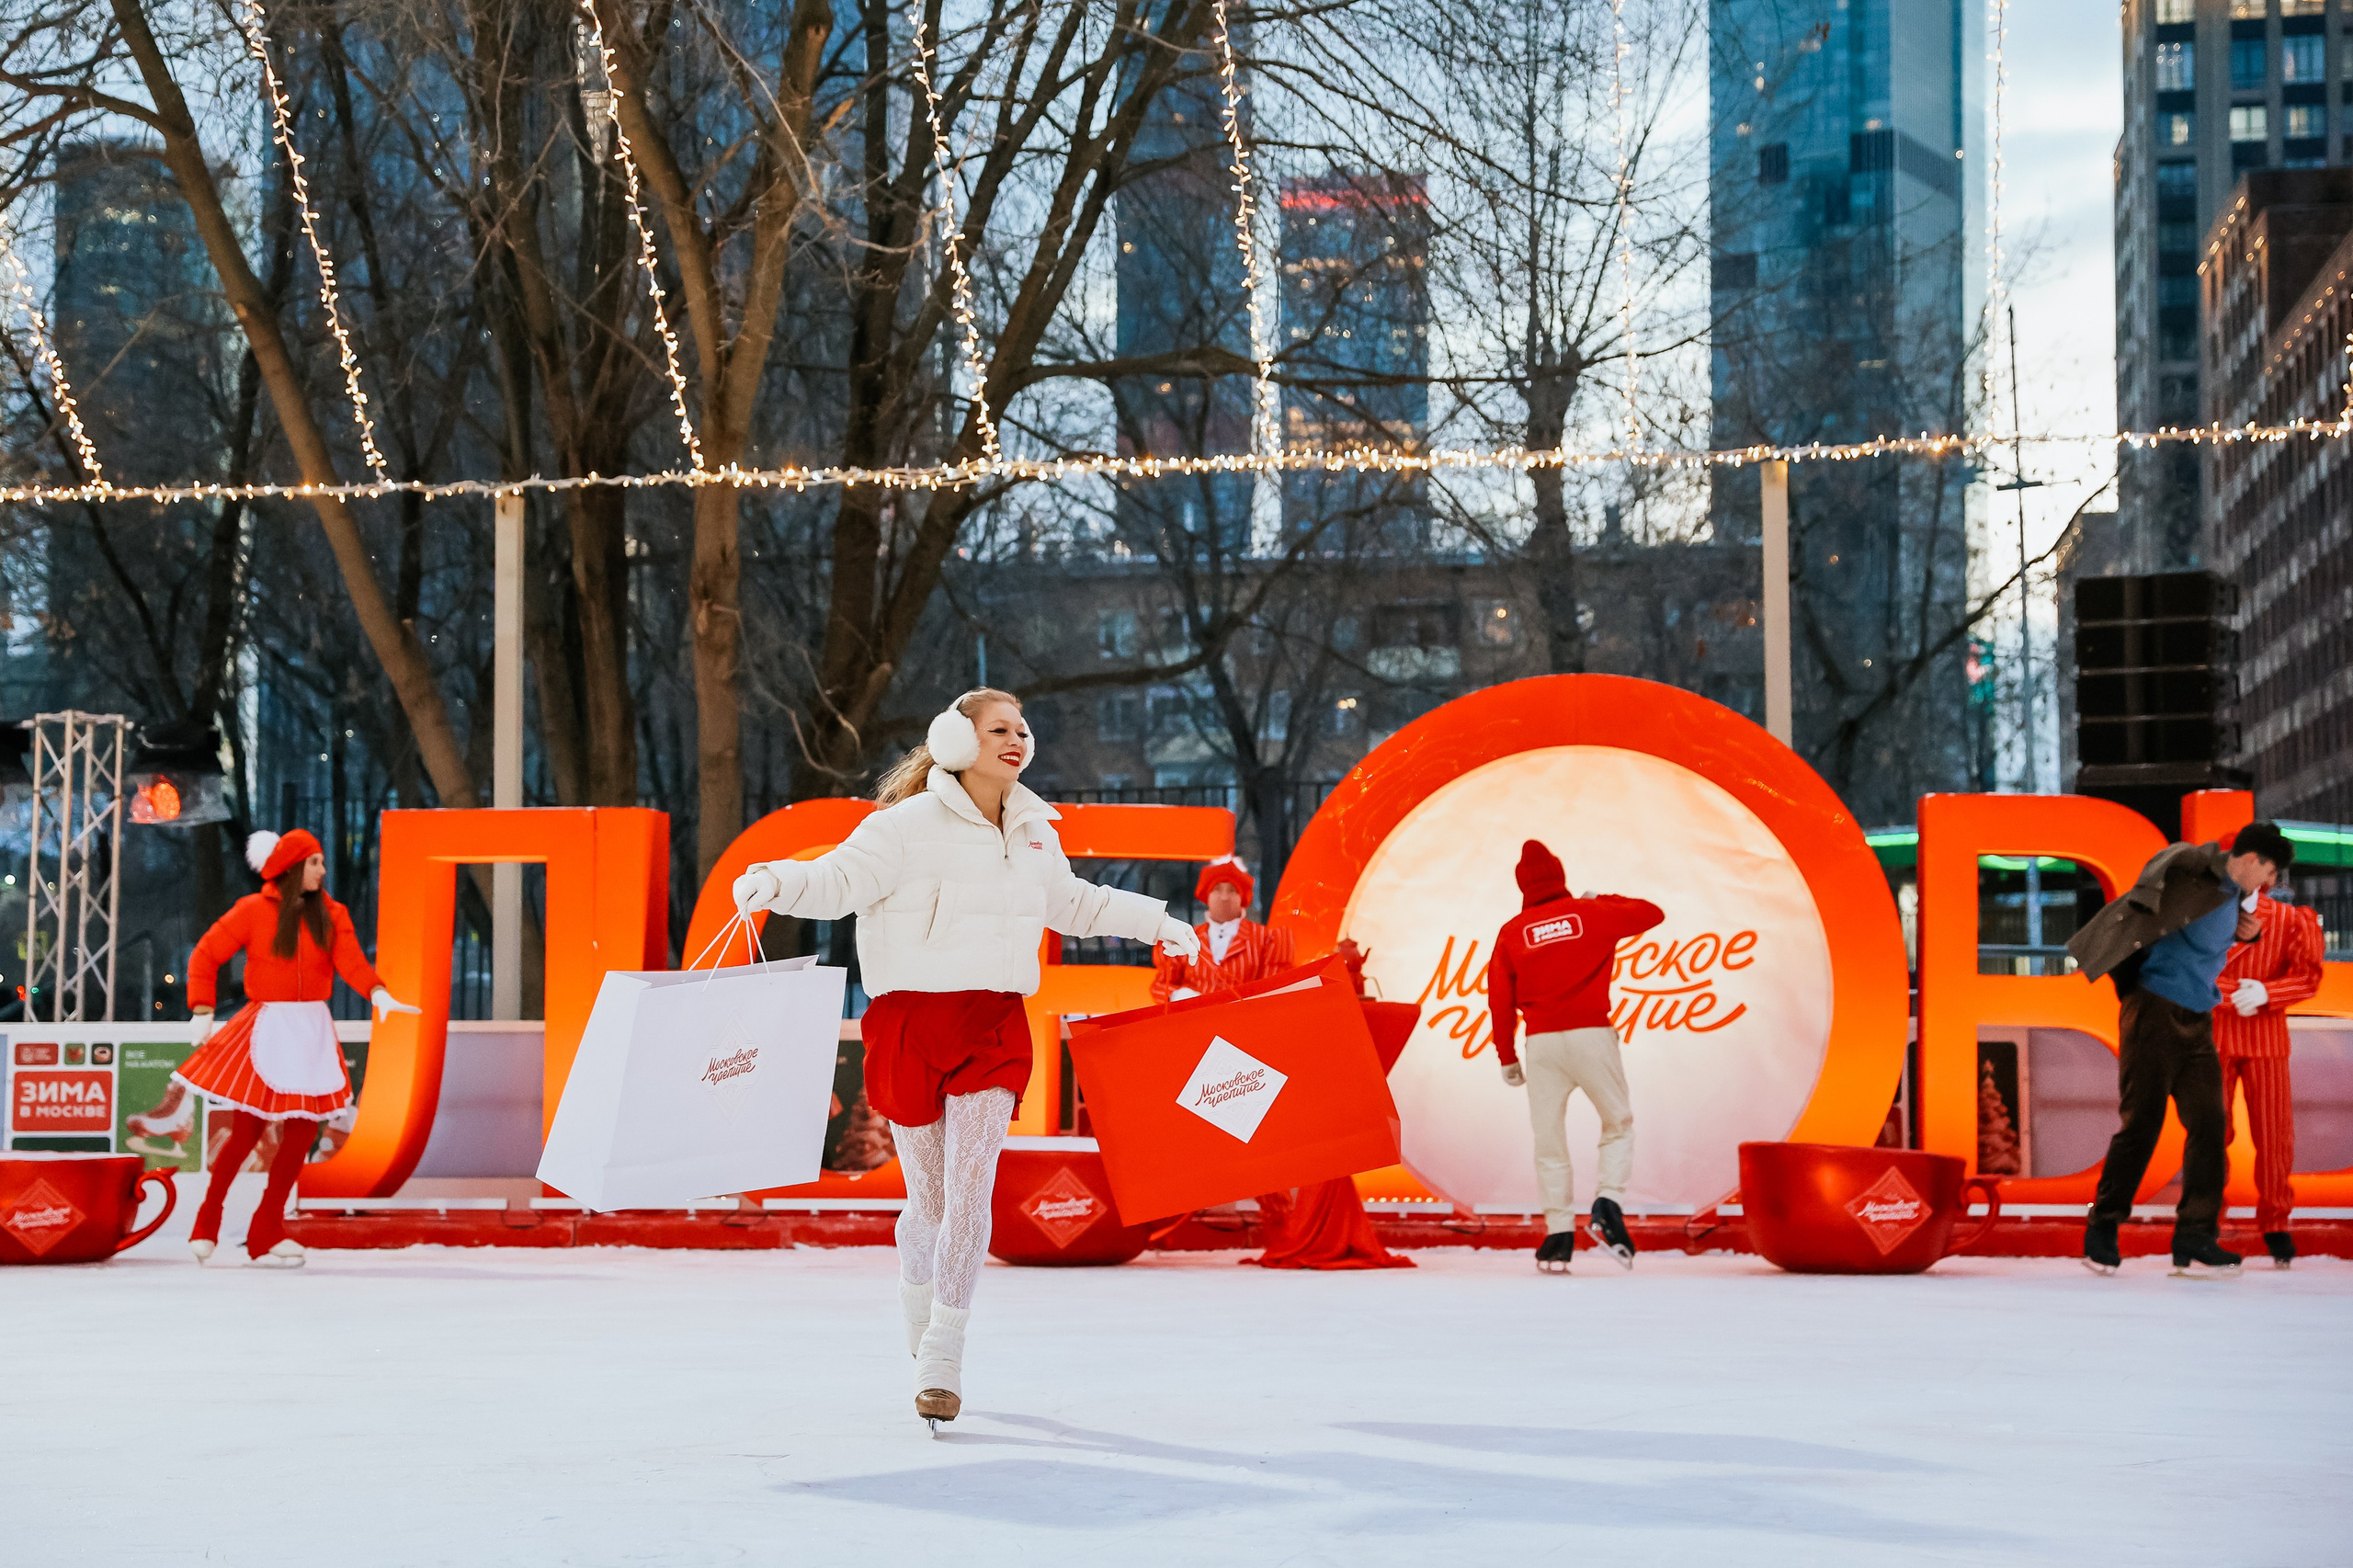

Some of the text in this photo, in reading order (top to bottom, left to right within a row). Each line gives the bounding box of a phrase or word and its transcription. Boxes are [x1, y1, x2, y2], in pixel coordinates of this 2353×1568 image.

[1531, 919, 1573, 937] ЗИМА
[701, 1048, 758, 1082] Московское
[19, 1081, 107, 1103] ЗИМА
[1195, 1068, 1265, 1106] Московское
[19, 1105, 107, 1119] В МОСКВЕ
